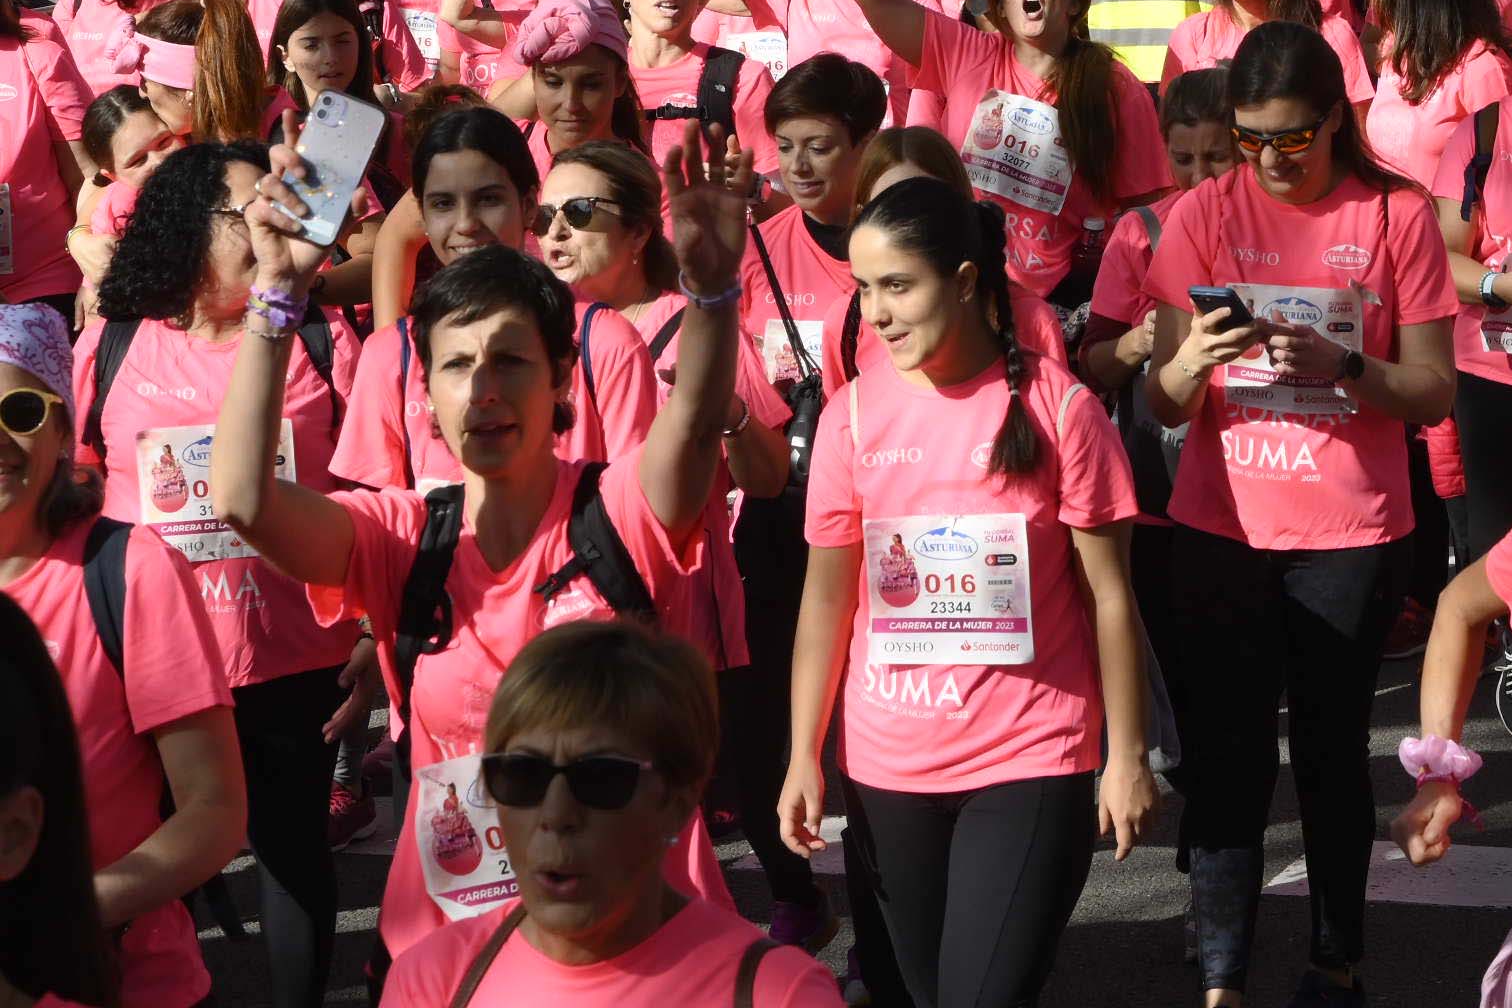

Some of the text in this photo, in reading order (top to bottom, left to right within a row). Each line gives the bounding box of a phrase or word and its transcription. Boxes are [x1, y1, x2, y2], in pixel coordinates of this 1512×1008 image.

[1004, 134, 1041, 159] 016
[1002, 152, 1031, 170] 32077
[1239, 369, 1275, 382] CARRERA
[861, 447, 923, 469] OYSHO
[1219, 429, 1319, 471] SUMA
[160, 524, 204, 534] CARRERA
[204, 522, 217, 530] DE
[919, 540, 974, 554] ASTURIANA
[984, 534, 1016, 544] SUMA
[923, 572, 977, 594] 016
[929, 600, 973, 614] 23344
[887, 620, 1016, 631] CARRERA DE LA MUJER 2023
[883, 641, 1020, 653] OYSHO Santander
[863, 662, 965, 708] SUMA
[456, 885, 503, 904] CARRERA
